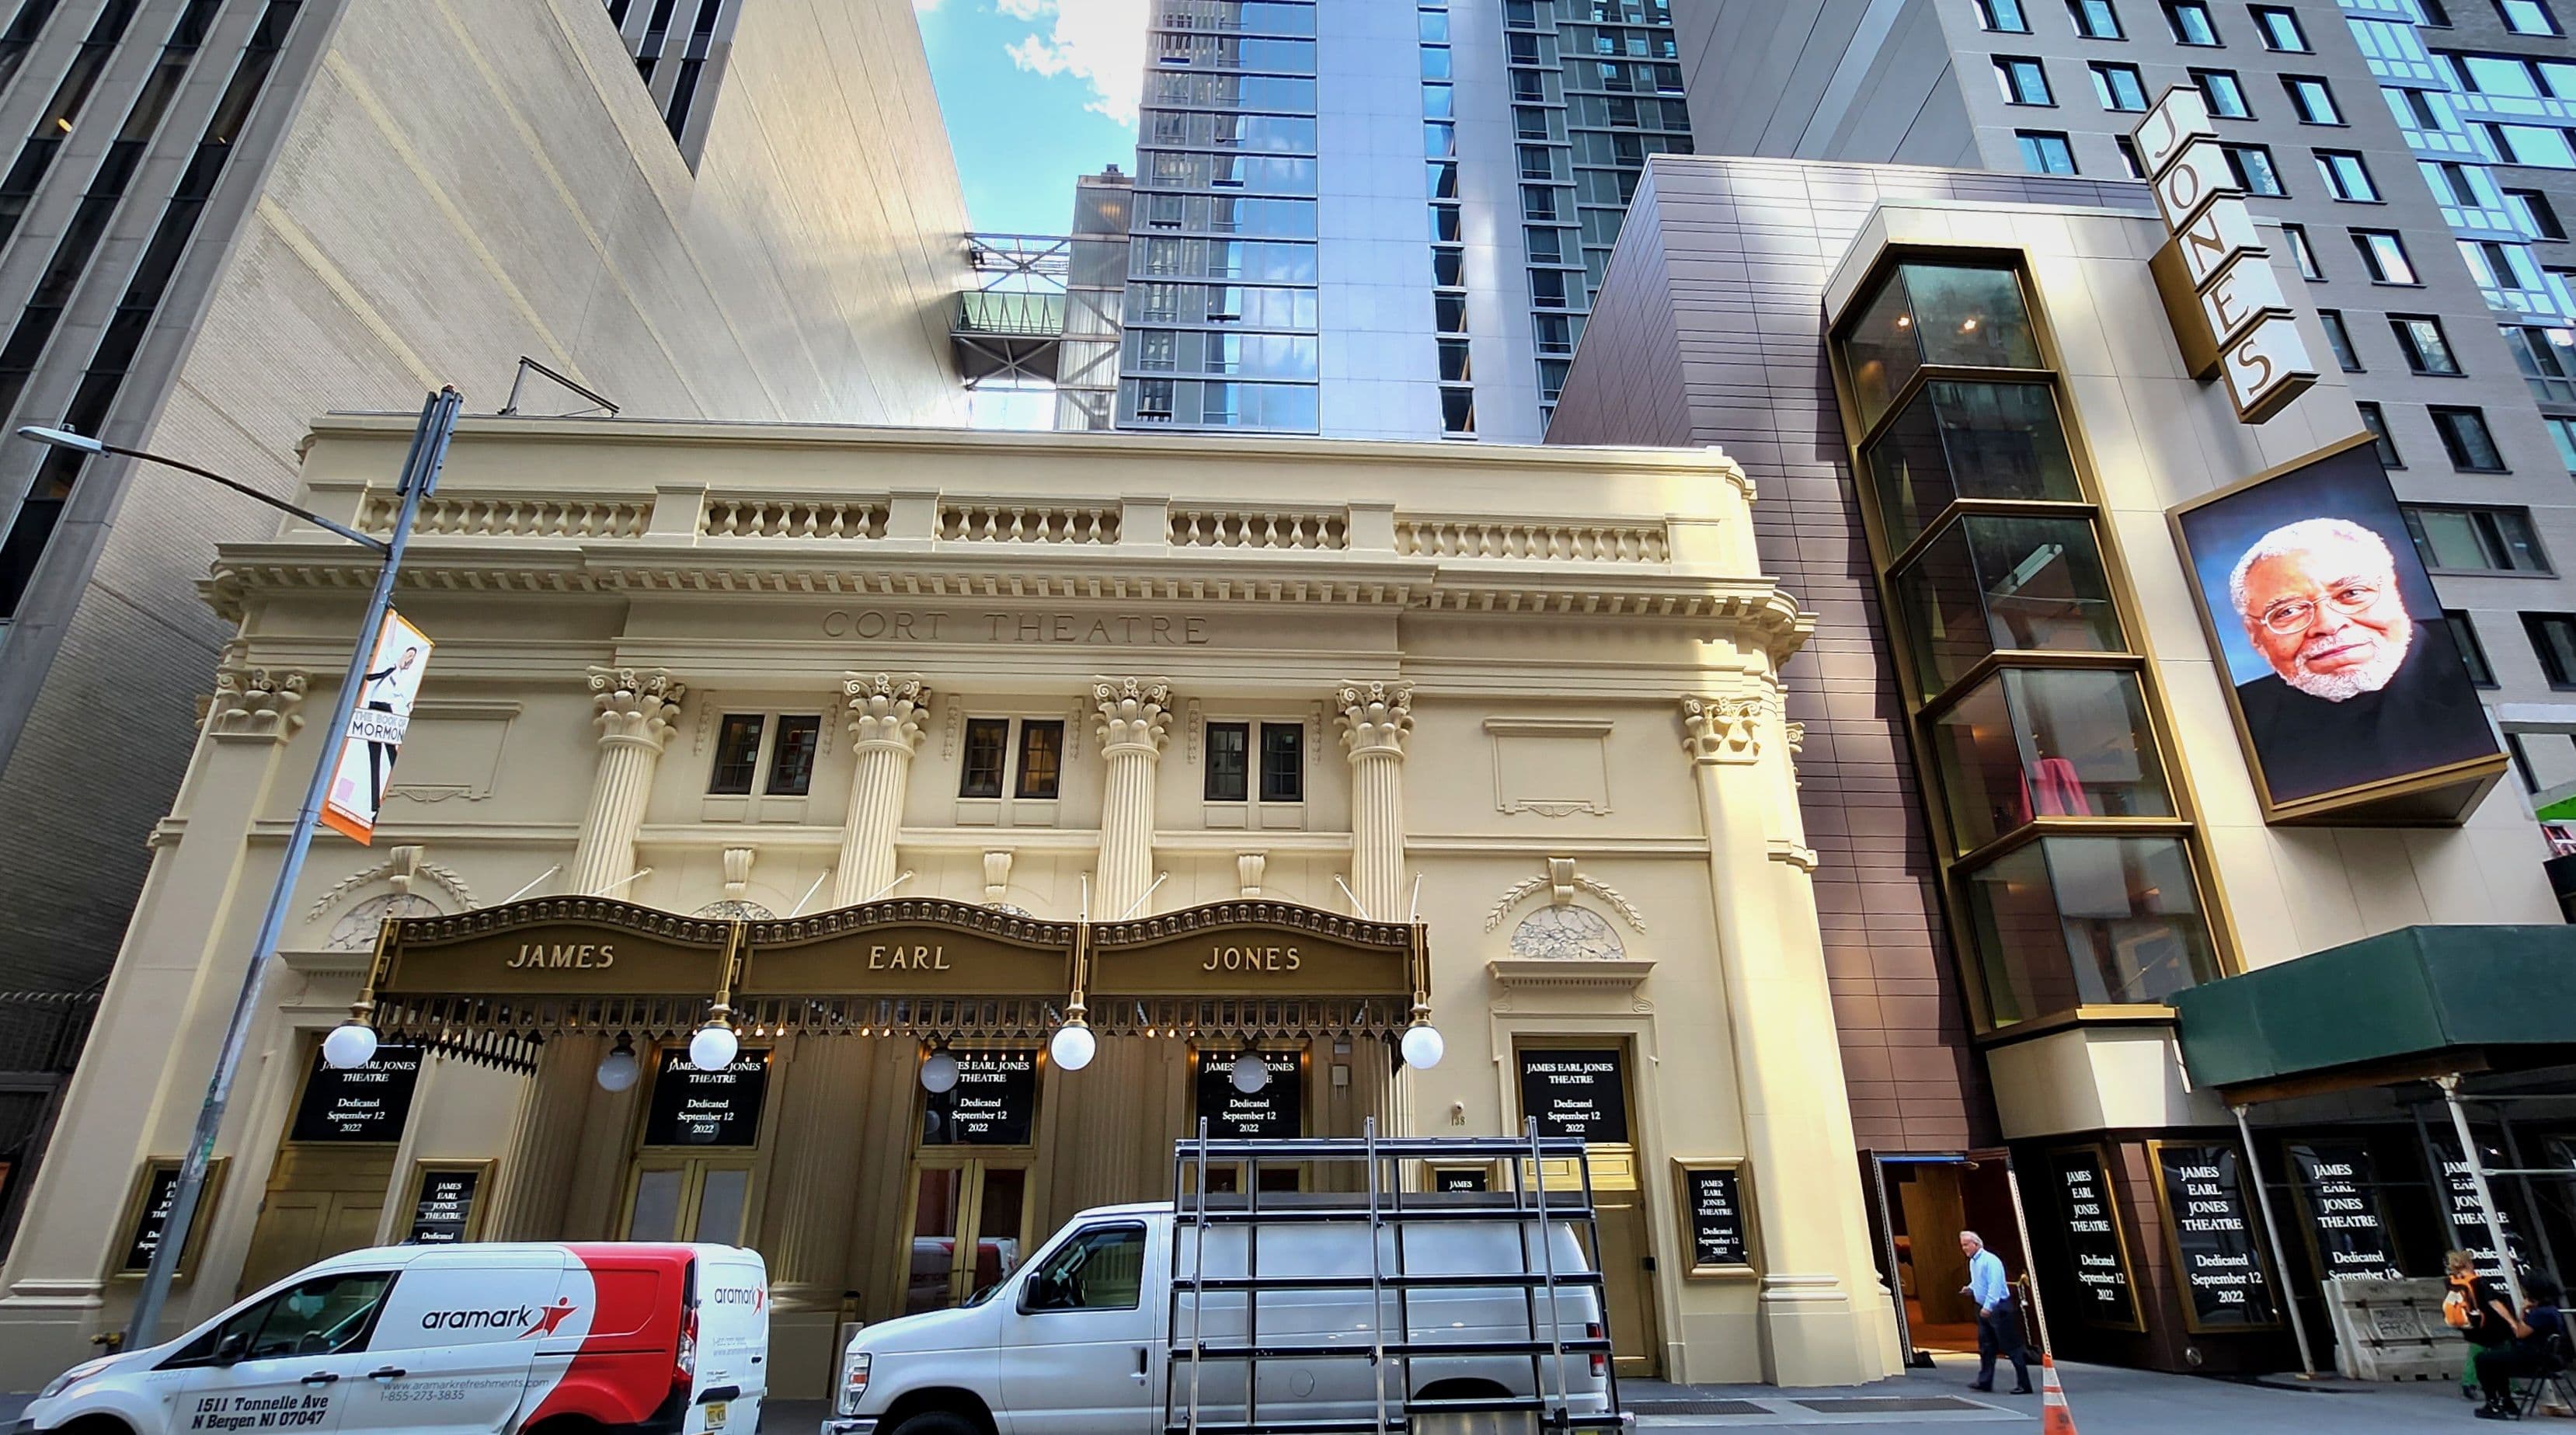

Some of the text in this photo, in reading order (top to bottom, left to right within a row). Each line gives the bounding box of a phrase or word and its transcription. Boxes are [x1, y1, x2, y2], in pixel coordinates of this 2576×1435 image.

[2154, 101, 2271, 395] JONES
[822, 611, 1210, 644] CORT THEATRE
[356, 711, 373, 722] THE
[352, 721, 404, 741] MORMON
[506, 944, 1301, 972] JAMES EARL JONES
[381, 1061, 416, 1071] JONES
[727, 1062, 761, 1073] JONES
[971, 1061, 997, 1070] EARL
[997, 1061, 1029, 1072] JONES
[1265, 1062, 1294, 1071] ONES
[1526, 1064, 1556, 1074] JAMES
[1582, 1064, 1613, 1074] JONES
[689, 1075, 736, 1083] THEATRE
[960, 1074, 1007, 1082] THEATRE
[1548, 1075, 1594, 1084] THEATRE
[337, 1099, 380, 1107] Dedicated
[687, 1099, 729, 1108] Dedicated
[960, 1099, 1001, 1107] Dedicated
[1230, 1099, 1269, 1108] Dedicated
[1554, 1099, 1593, 1108] Dedicated
[327, 1111, 372, 1122] September
[677, 1112, 722, 1123] September
[952, 1110, 1007, 1121] September 12
[1222, 1112, 1265, 1123] September
[1451, 1116, 1465, 1126] 138
[1547, 1112, 1589, 1122] September
[968, 1123, 988, 1132] 2022
[2180, 1166, 2219, 1181] JAMES
[2313, 1164, 2352, 1179] JAMES
[2066, 1170, 2092, 1186] JAMES
[2451, 1179, 2478, 1189] EAR
[436, 1182, 462, 1191] JAMES
[1449, 1181, 1472, 1189] JAMES
[2187, 1184, 2222, 1196] EARL
[2072, 1187, 2094, 1199] EARL
[1703, 1199, 1725, 1207] JONES
[2188, 1201, 2229, 1216] JONES
[2323, 1199, 2363, 1214] JONES
[2454, 1195, 2482, 1210] JON
[2073, 1203, 2100, 1218] JONES
[2318, 1216, 2377, 1228] THEATRE
[2452, 1212, 2509, 1224] THEAE
[2070, 1221, 2111, 1231] THEATRE
[2181, 1218, 2244, 1231] THEATRE
[1698, 1237, 1730, 1246] September
[2081, 1254, 2115, 1266] Dedicated
[2195, 1253, 2248, 1266] Dedicated
[2333, 1250, 2384, 1263] Dedicated
[2078, 1271, 2125, 1286] September 12
[2191, 1272, 2263, 1289] September 12
[714, 1285, 756, 1305] aramark
[2097, 1289, 2115, 1301] 2022
[2217, 1291, 2245, 1303] 2022
[422, 1305, 532, 1329] aramark
[384, 1378, 550, 1391] www.aramarkrefreshments.com
[381, 1390, 465, 1402] 1-855-273-3835
[197, 1395, 329, 1412] 1511 Tonnelle Ave
[192, 1410, 327, 1431] N Bergen NJ 07047
